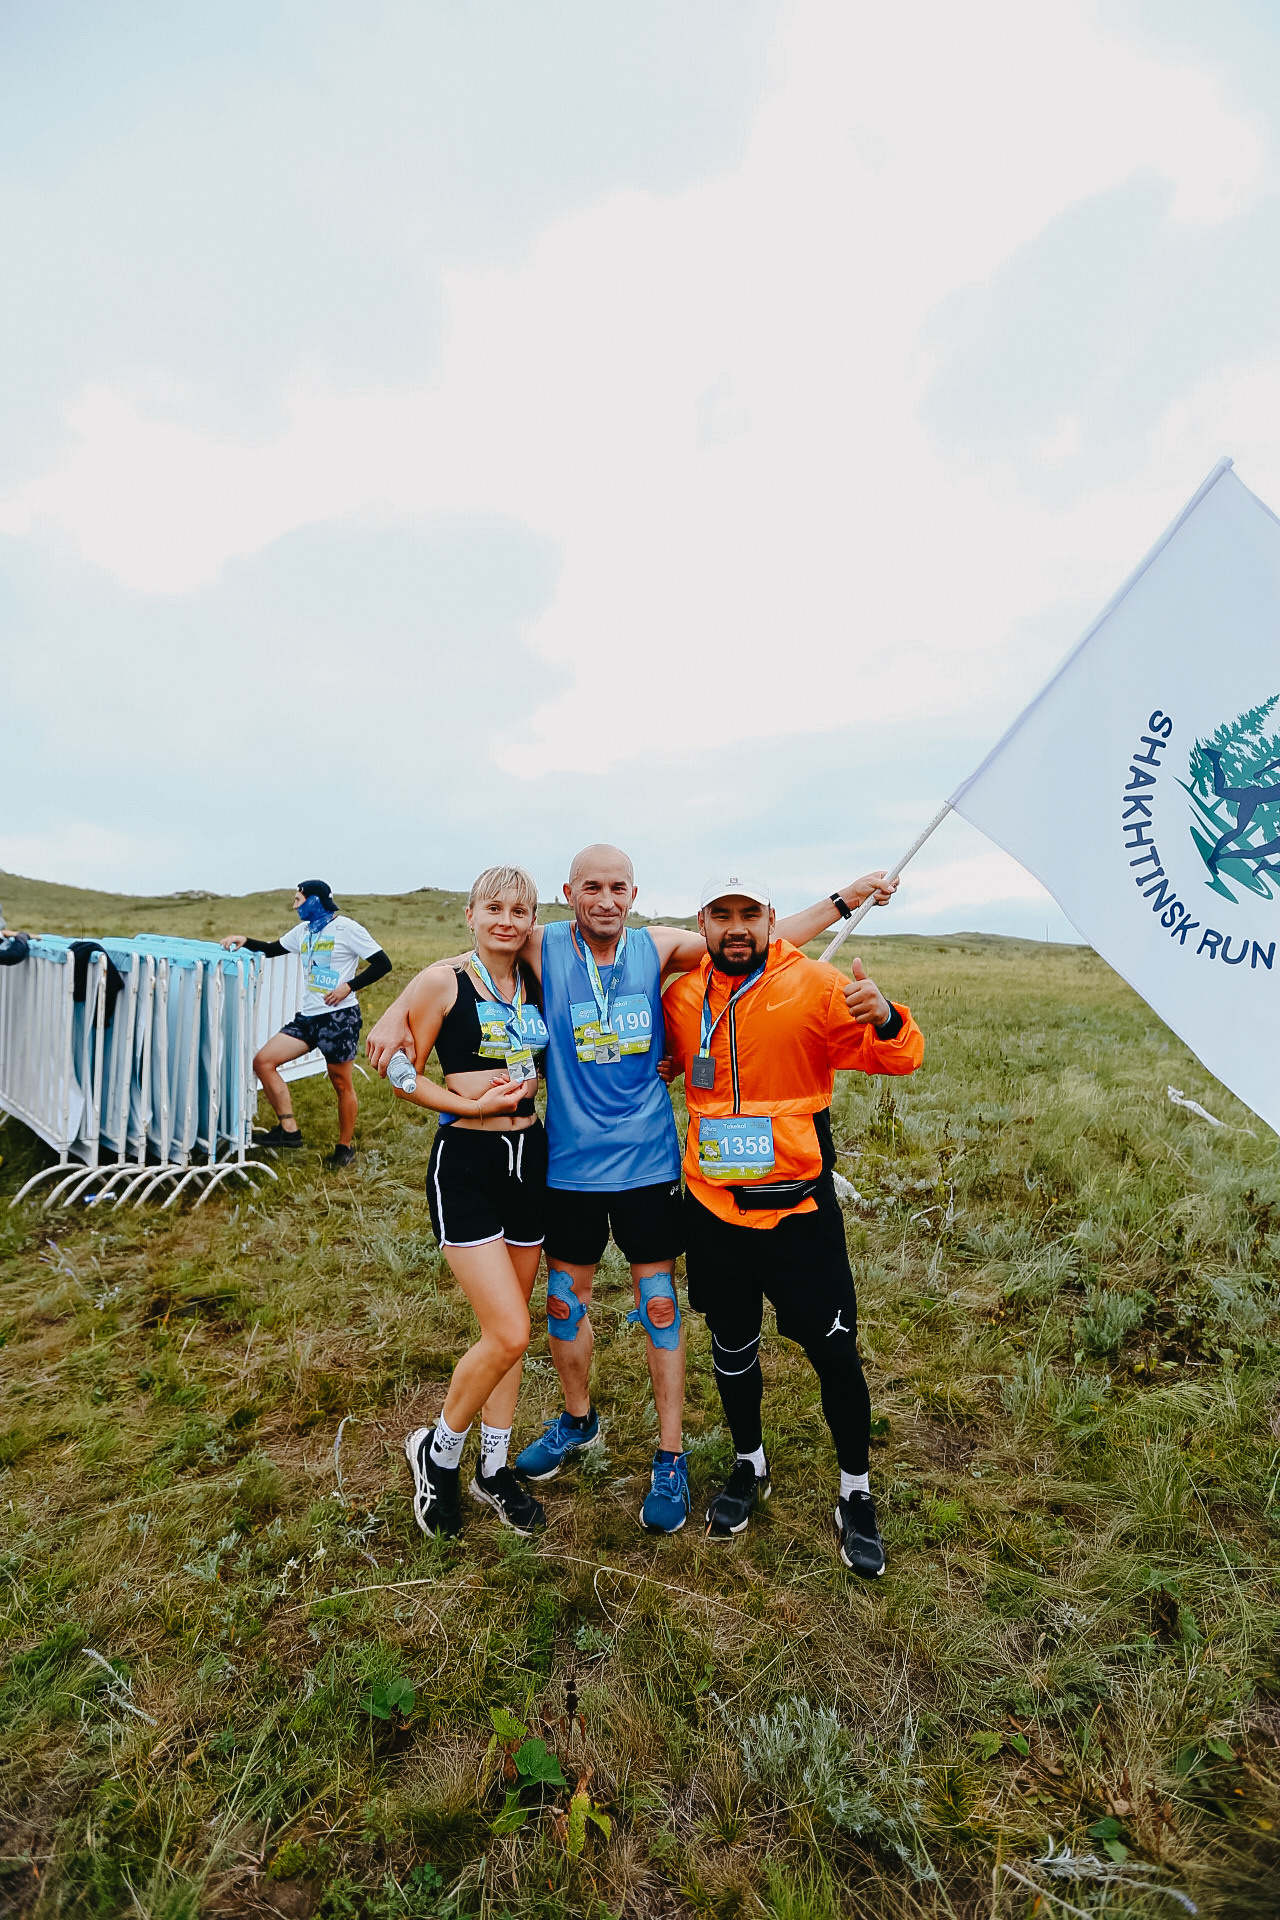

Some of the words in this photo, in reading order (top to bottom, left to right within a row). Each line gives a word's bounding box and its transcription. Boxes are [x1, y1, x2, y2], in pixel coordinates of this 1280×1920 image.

[1122, 709, 1201, 946] SHAKHTINSK
[1196, 928, 1277, 970] RUN
[315, 974, 337, 986] 1304
[720, 1135, 771, 1156] 1358
